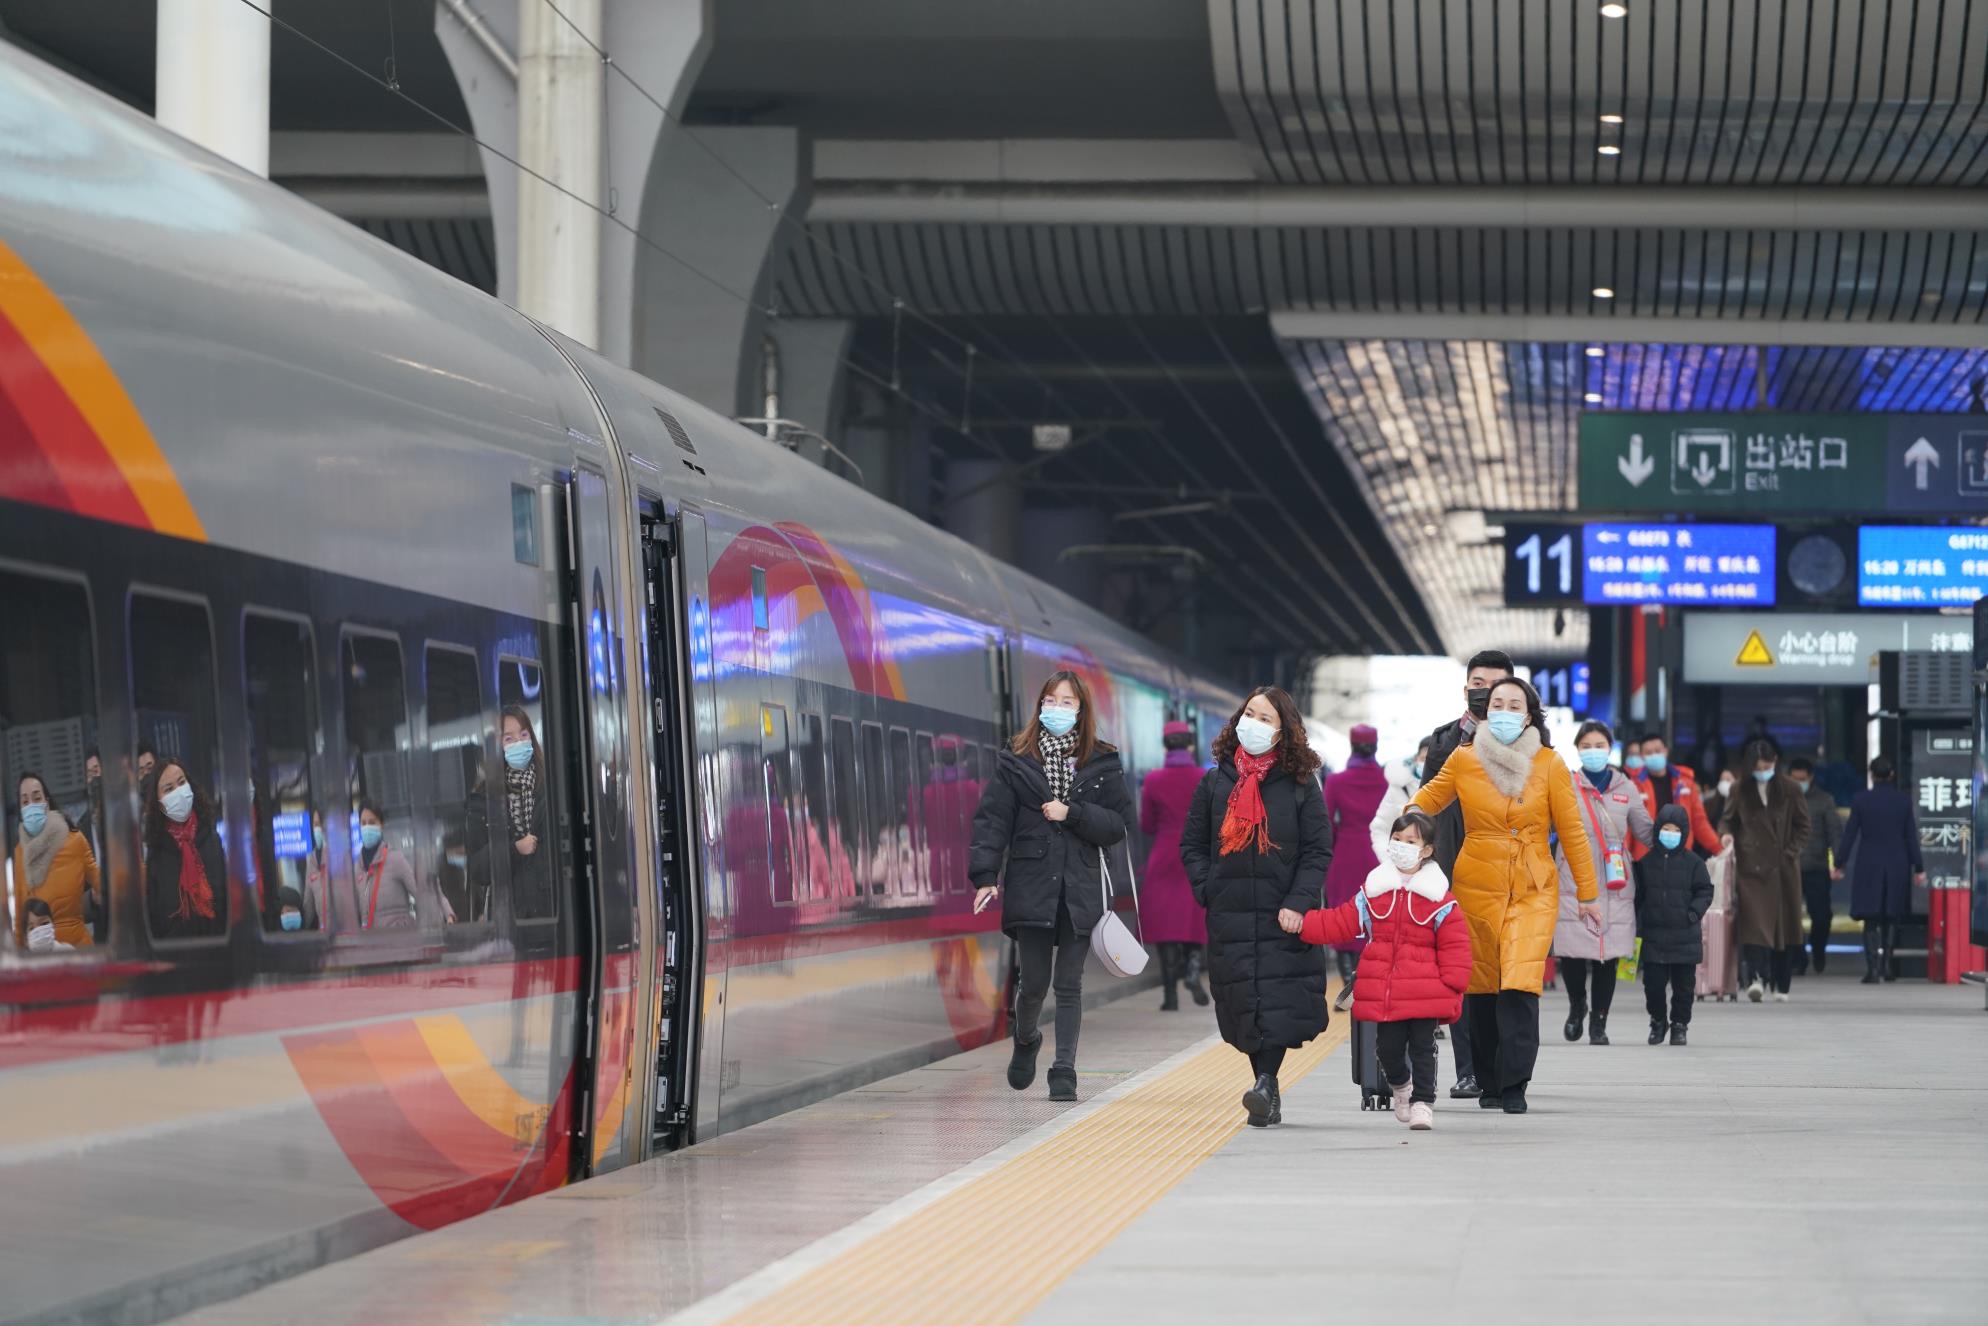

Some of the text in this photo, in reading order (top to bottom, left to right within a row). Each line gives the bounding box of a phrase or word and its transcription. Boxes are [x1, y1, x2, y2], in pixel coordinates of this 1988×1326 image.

[1745, 433, 1847, 470] 出站口
[1745, 472, 1779, 491] Exit
[1515, 533, 1572, 593] 11
[1779, 630, 1858, 653] 小心台阶
[1533, 669, 1568, 705] 11
